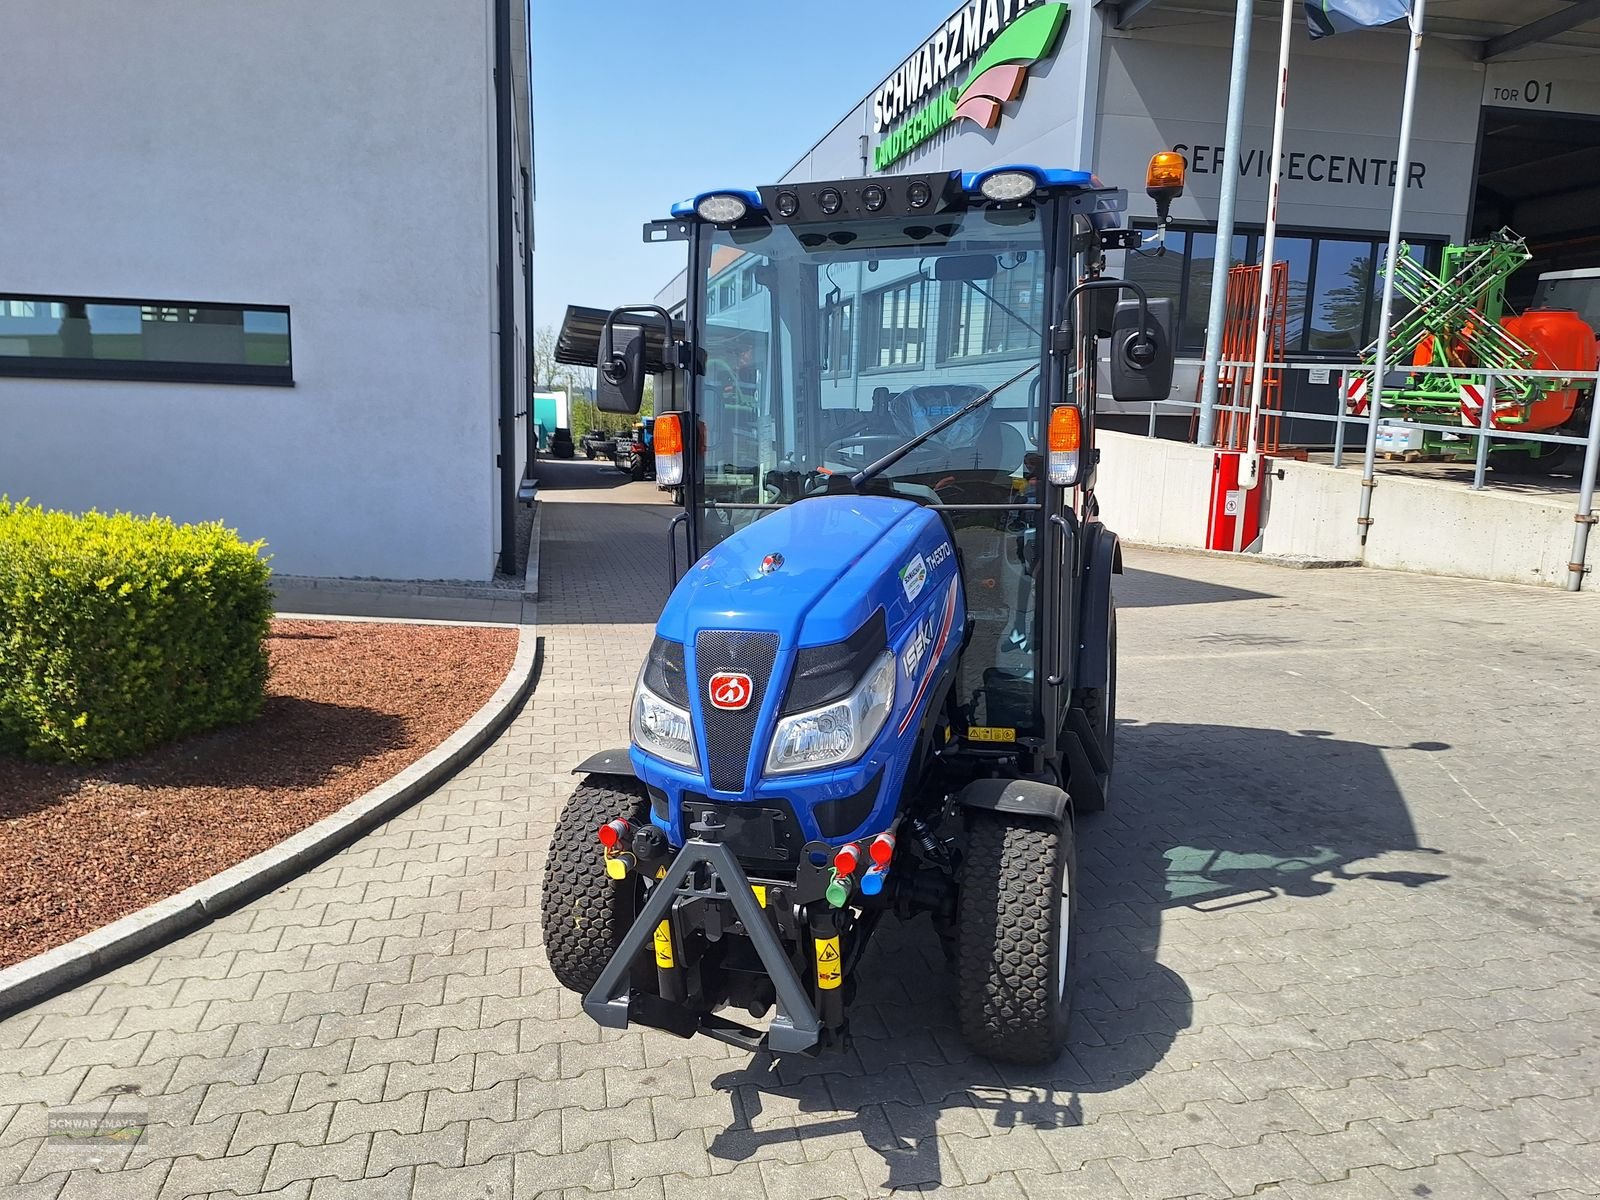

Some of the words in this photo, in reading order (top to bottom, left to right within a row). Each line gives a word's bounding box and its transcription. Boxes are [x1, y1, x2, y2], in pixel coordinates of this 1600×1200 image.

[873, 0, 1041, 134] SCHWARZMA
[1494, 87, 1519, 101] TOR
[1524, 80, 1553, 104] 01
[873, 87, 958, 172] LANDTECHNIK
[925, 541, 951, 572] TH5370
[902, 616, 934, 678] ISEKI
